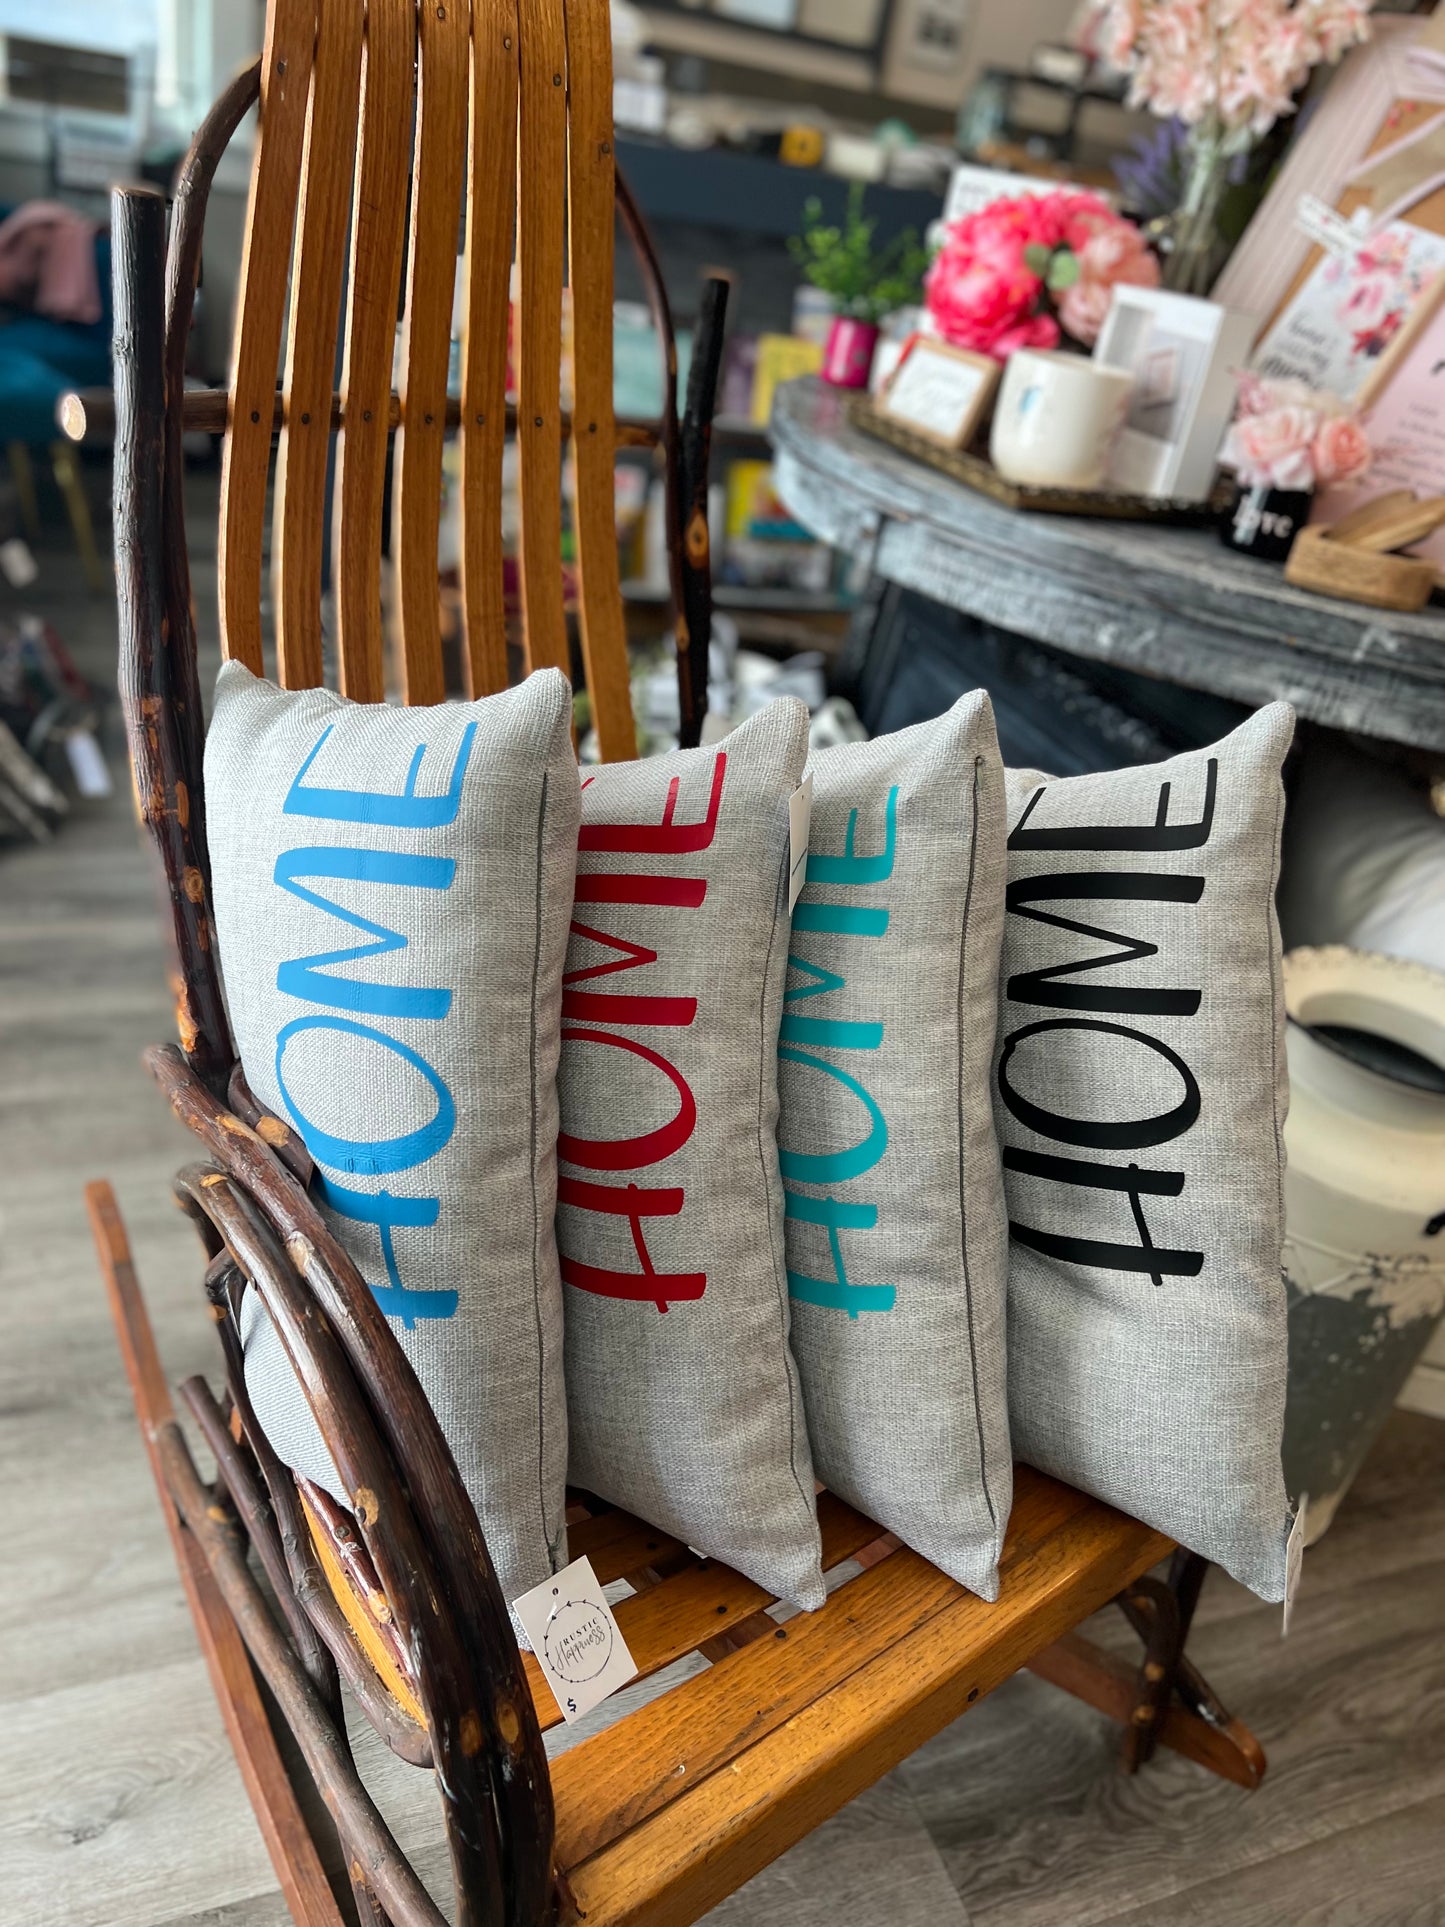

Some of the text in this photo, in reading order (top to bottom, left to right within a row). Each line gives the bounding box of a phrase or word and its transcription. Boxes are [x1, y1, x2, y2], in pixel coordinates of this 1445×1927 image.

[275, 721, 478, 1330] HOME
[999, 757, 1218, 1287] HOME
[555, 1625, 606, 1671] Happiness
[562, 1616, 598, 1647] RUSTIC
